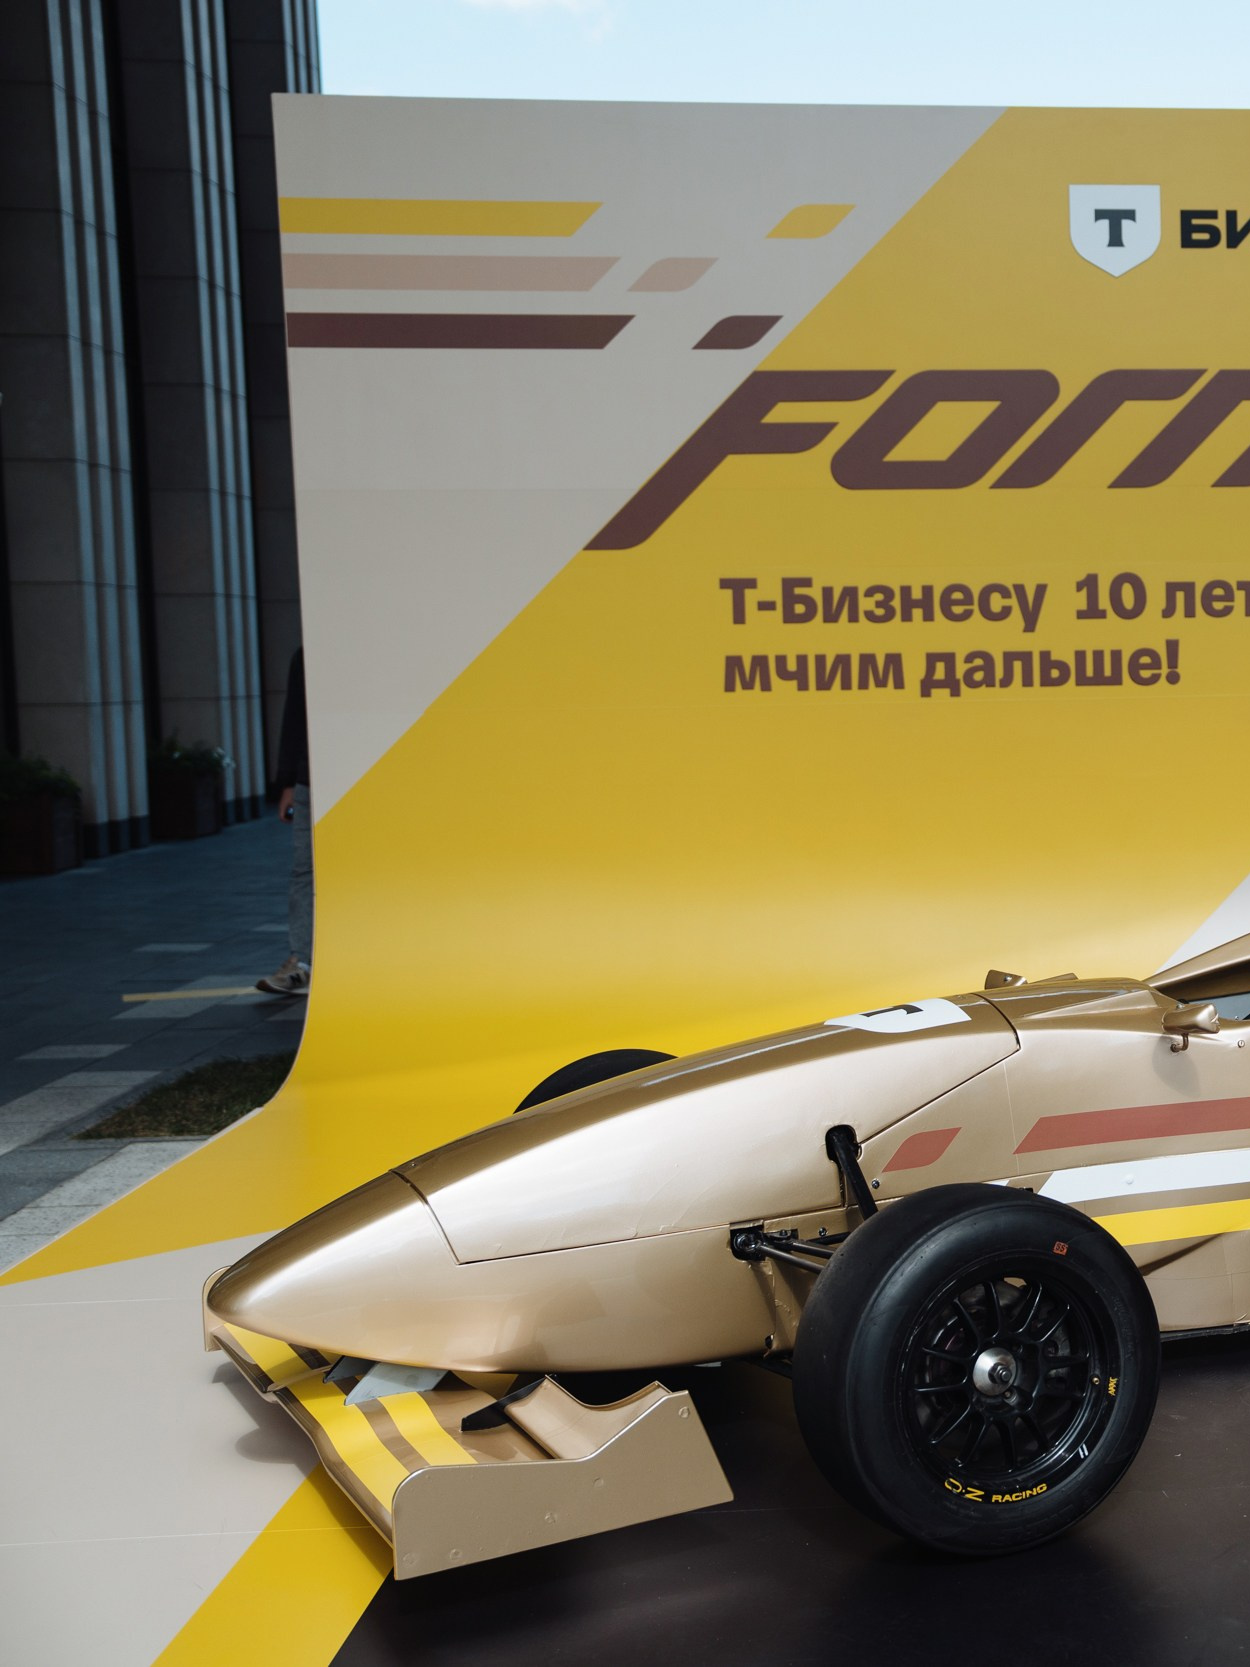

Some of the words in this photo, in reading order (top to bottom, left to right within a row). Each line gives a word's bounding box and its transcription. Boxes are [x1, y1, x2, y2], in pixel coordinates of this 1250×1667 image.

[719, 576, 1048, 632] Т-Бизнесу
[1075, 572, 1148, 620] 10
[723, 652, 905, 693] мчим
[920, 639, 1181, 697] дальше!
[991, 1483, 1048, 1503] RACING
